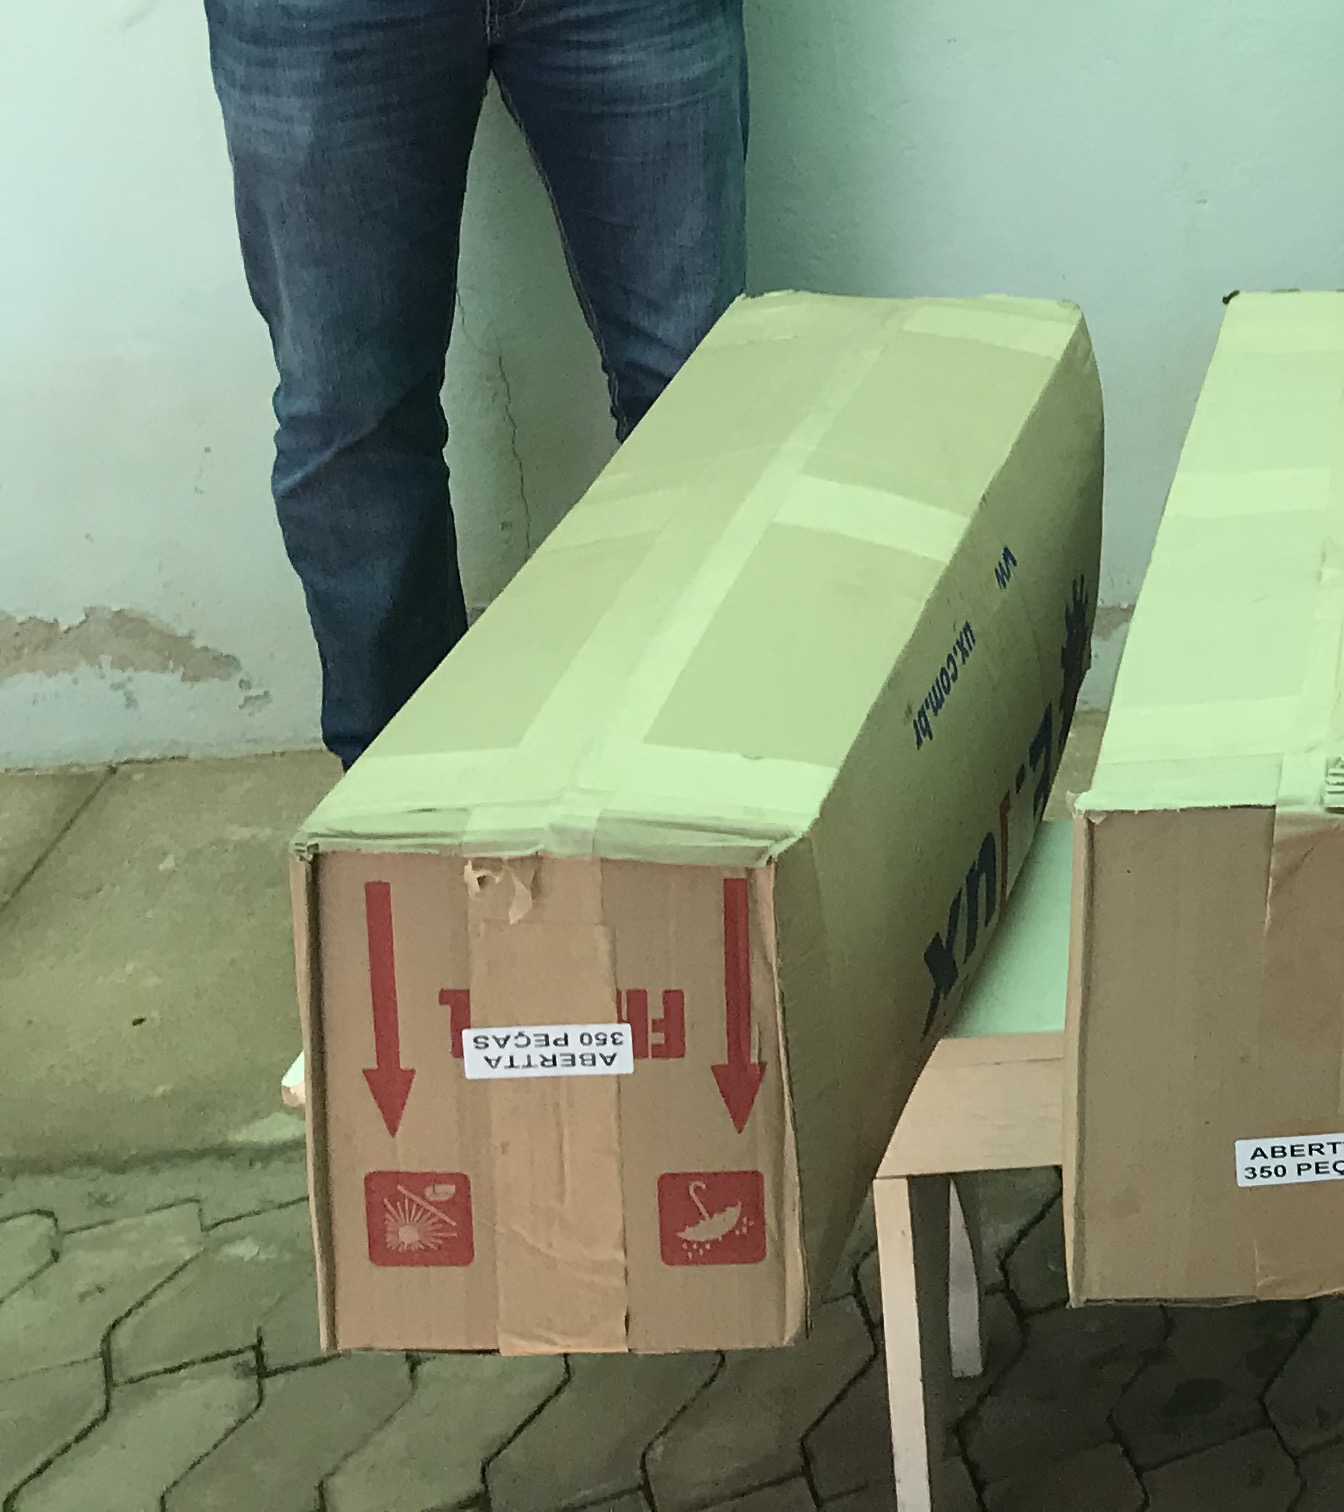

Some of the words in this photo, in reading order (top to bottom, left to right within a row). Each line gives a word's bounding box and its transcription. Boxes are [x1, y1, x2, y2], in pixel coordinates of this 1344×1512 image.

[473, 1030, 569, 1050] PEÇAS
[579, 1031, 624, 1047] 350
[483, 1052, 618, 1070] ABERTTA
[1244, 1164, 1287, 1180] 350
